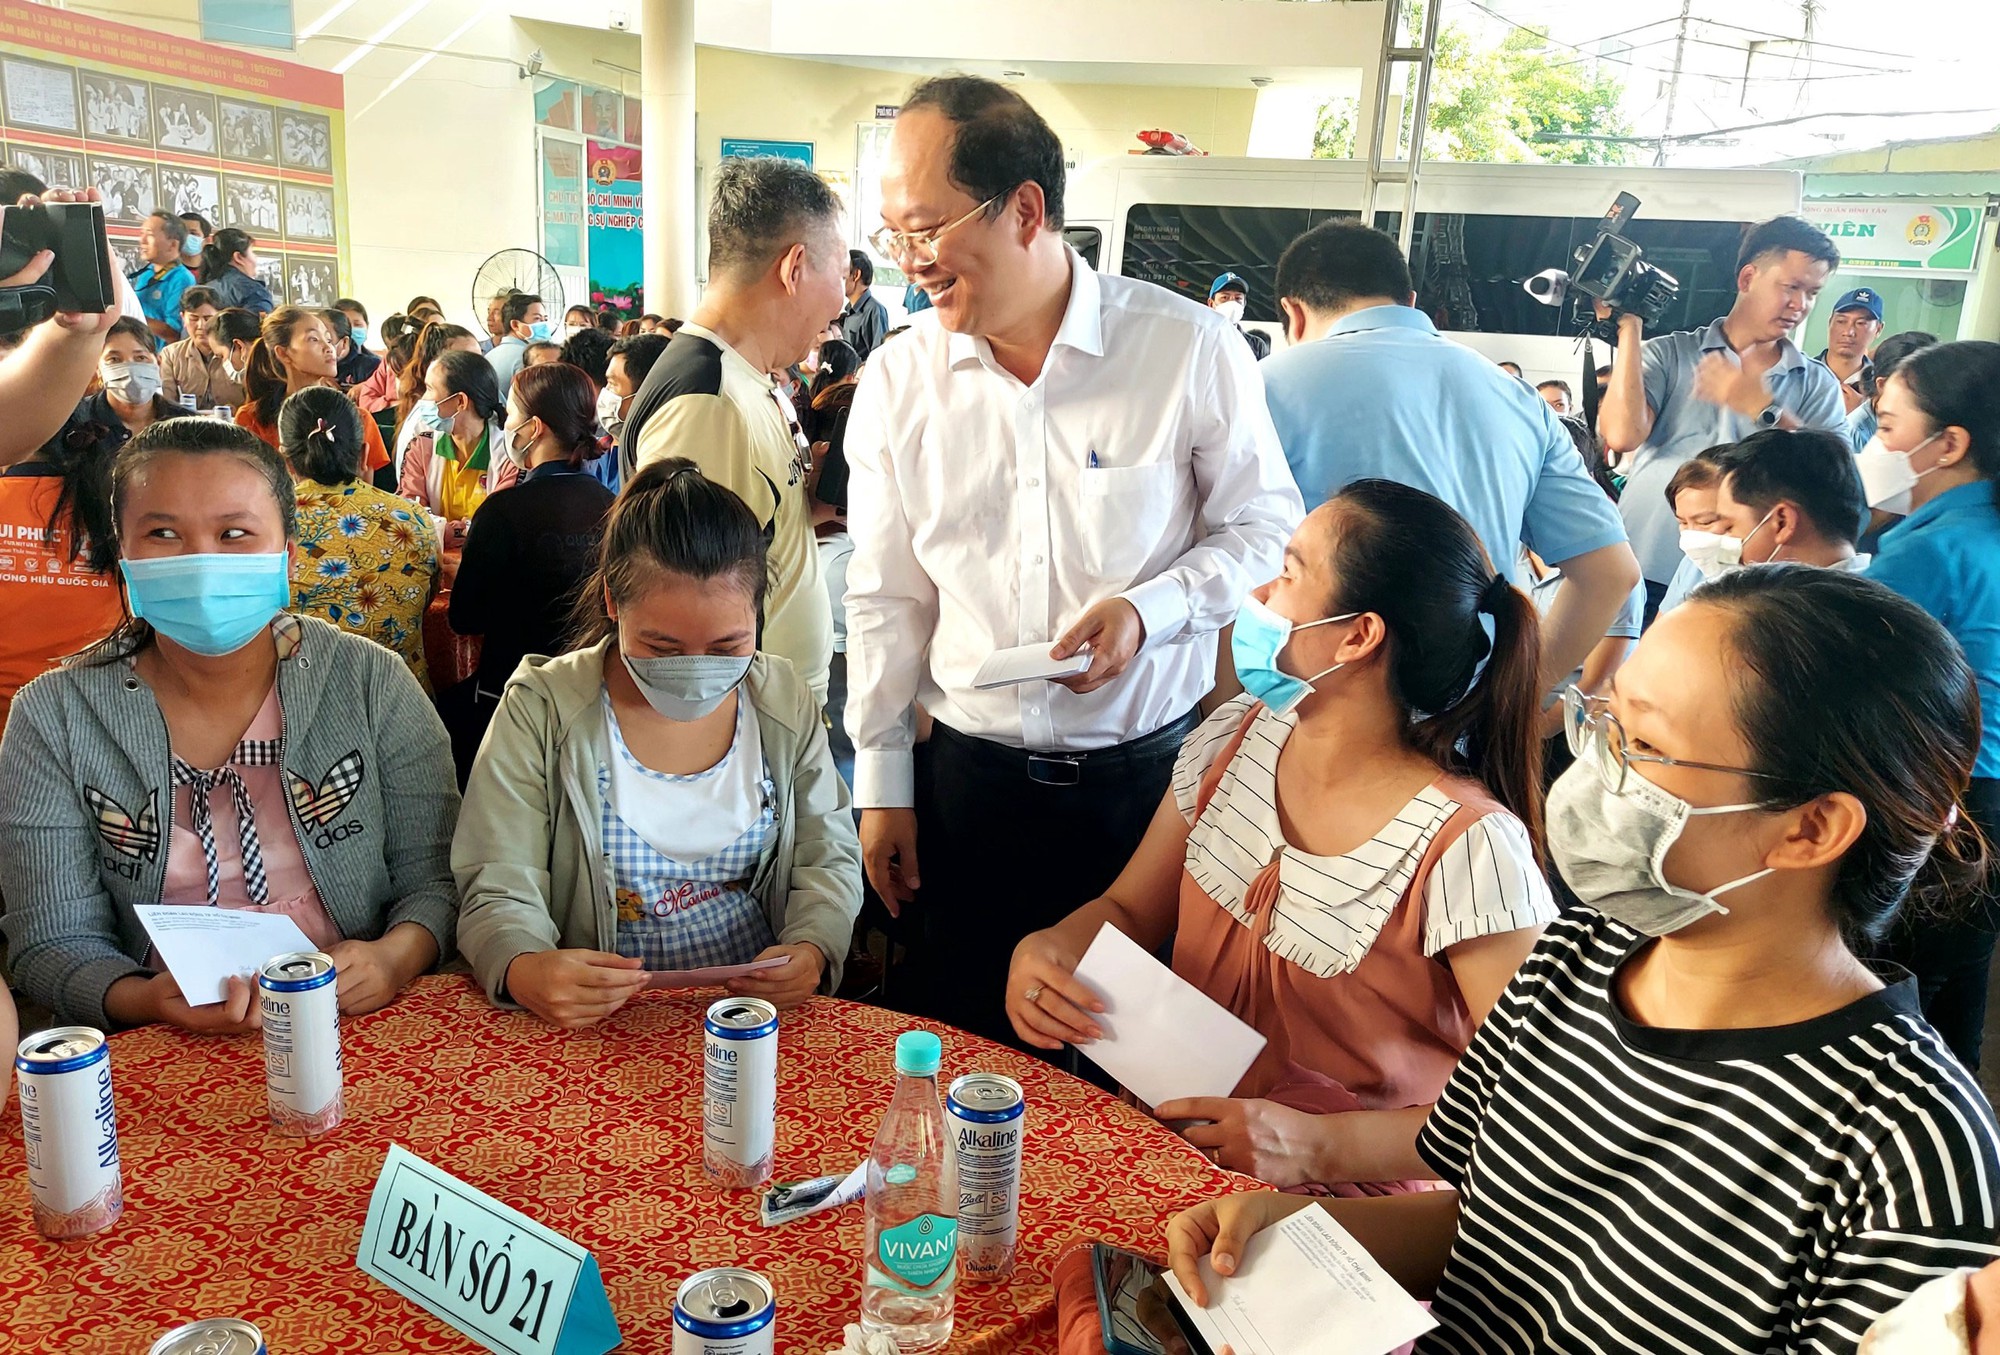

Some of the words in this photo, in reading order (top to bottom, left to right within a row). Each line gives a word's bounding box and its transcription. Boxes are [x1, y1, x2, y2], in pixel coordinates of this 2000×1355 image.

[598, 190, 611, 206] CHÍ
[613, 195, 632, 208] MINH
[596, 211, 607, 230] SỰ
[608, 211, 636, 231] NGHIỆP
[0, 523, 13, 538] UI
[30, 575, 55, 585] HIỆU
[57, 575, 88, 587] QUỐC
[91, 579, 109, 588] GIA
[314, 818, 364, 850] das
[103, 854, 143, 882] adi
[260, 995, 291, 1014] aline
[705, 1042, 738, 1063] aline
[958, 1127, 1018, 1148] Alkaline
[959, 1192, 985, 1206] Ball
[884, 1228, 956, 1259] VIVANT
[388, 1193, 466, 1290] BÀN
[458, 1234, 516, 1315] SỐ
[508, 1268, 554, 1343] 21
